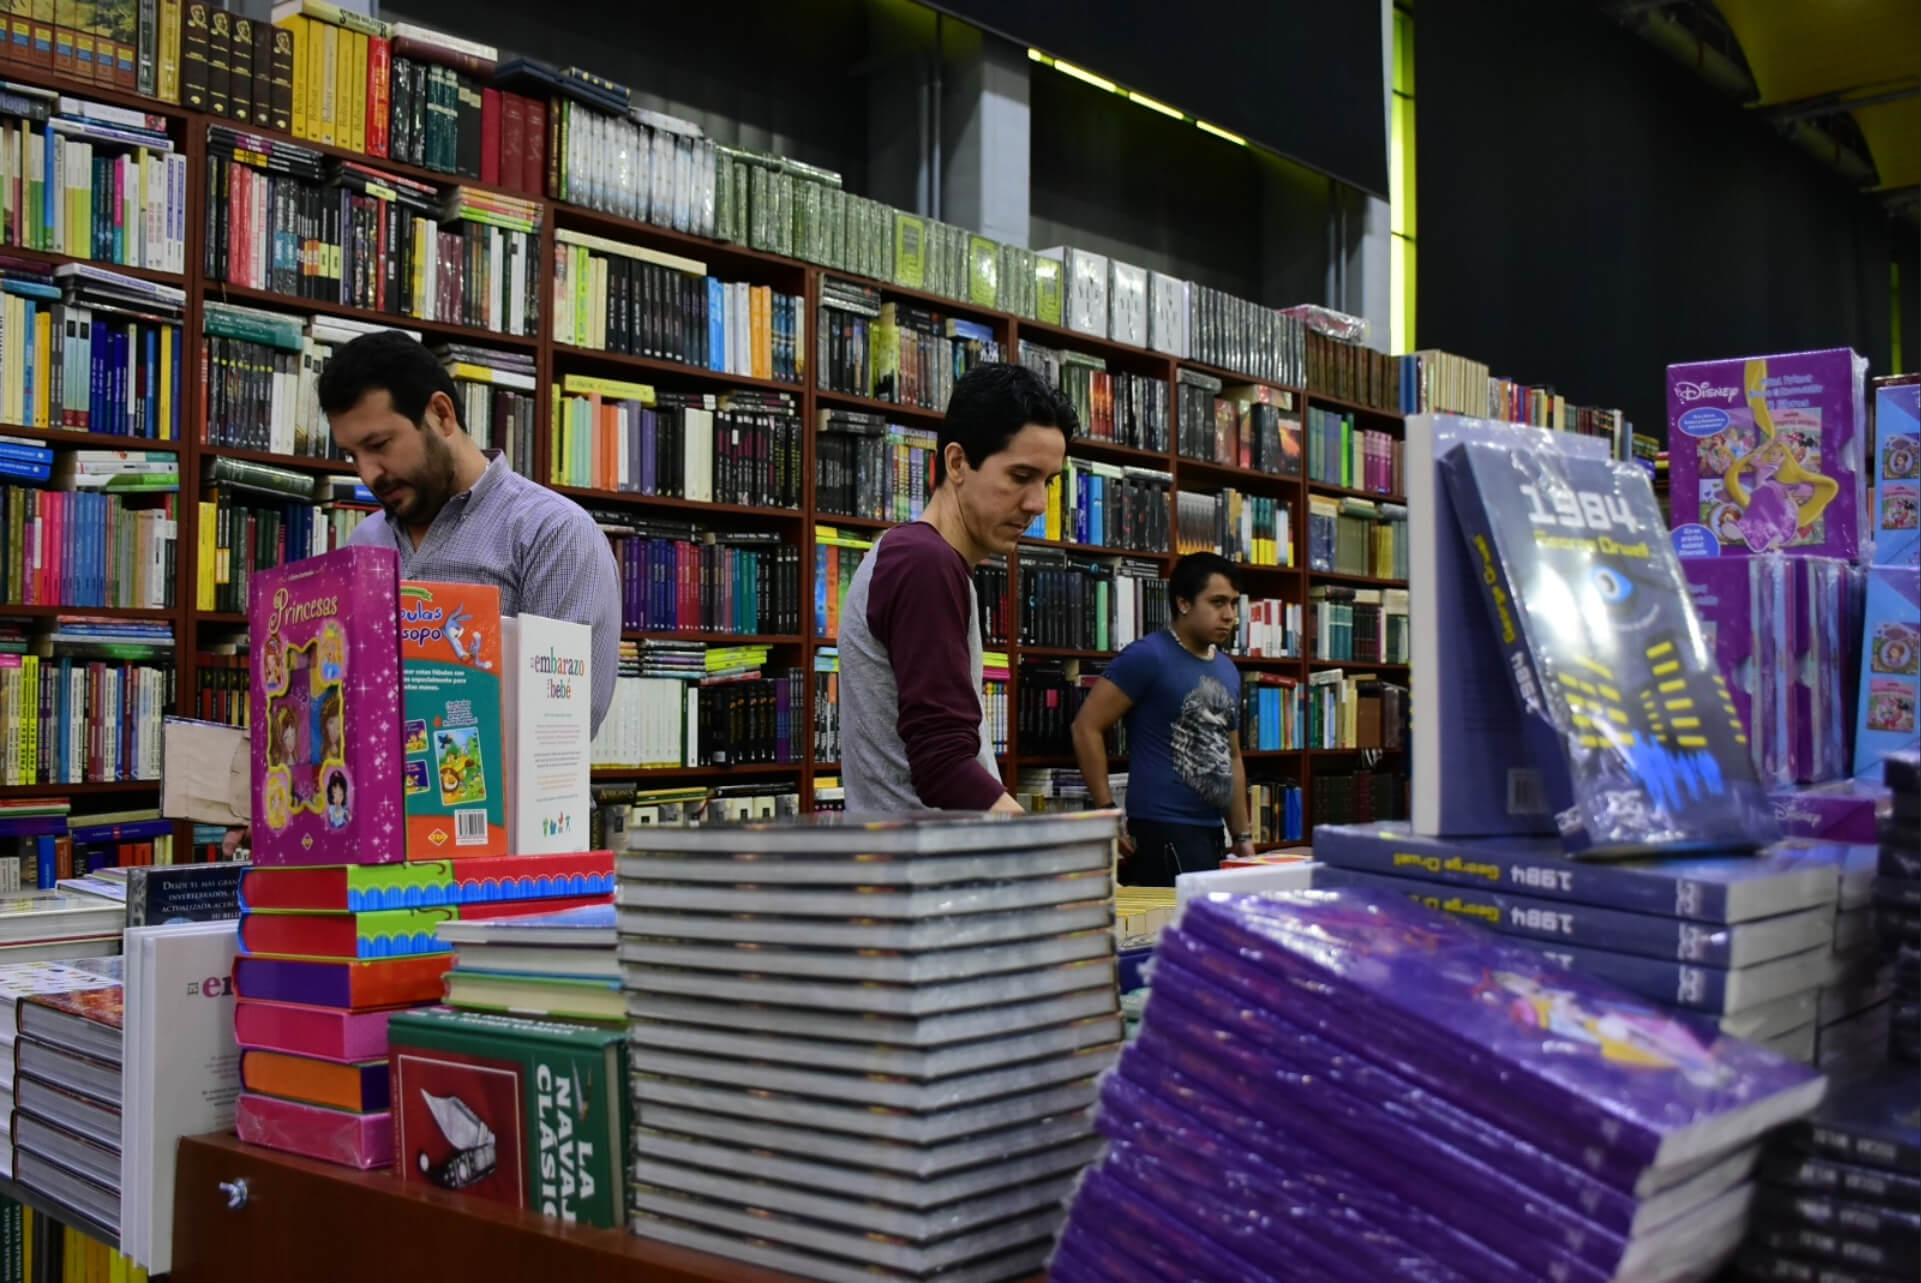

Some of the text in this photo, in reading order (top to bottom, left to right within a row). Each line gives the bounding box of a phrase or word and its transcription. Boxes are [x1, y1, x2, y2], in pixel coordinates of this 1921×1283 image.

[1519, 484, 1637, 534] 1984
[268, 587, 338, 633] Princesas
[534, 646, 586, 676] embarazo
[1510, 864, 1574, 892] 1984
[1511, 906, 1575, 934] 1984
[577, 1141, 595, 1199] LA
